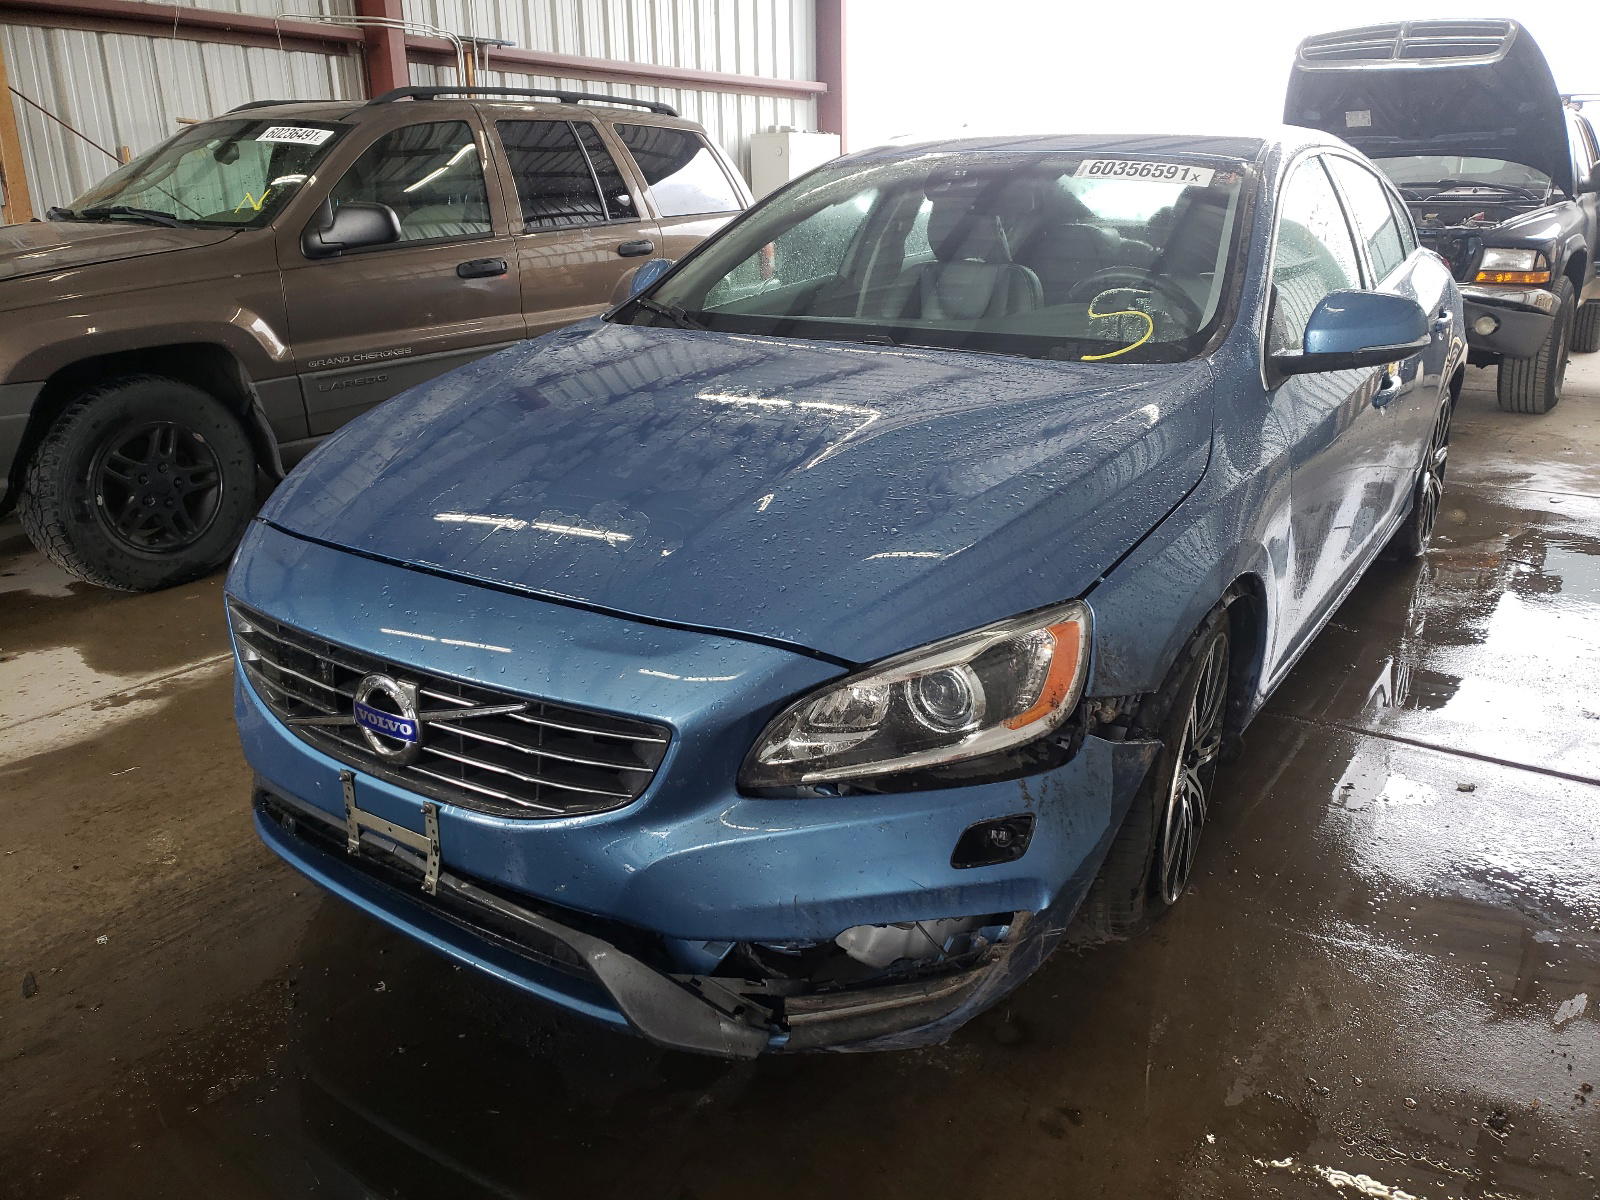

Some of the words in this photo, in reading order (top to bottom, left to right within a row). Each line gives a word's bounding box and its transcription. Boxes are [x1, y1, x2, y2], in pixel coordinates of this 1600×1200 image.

[308, 356, 350, 368] GRAND
[353, 347, 412, 360] CHEROKEE
[319, 375, 388, 392] LAREDO
[357, 707, 412, 735] VOLVO
